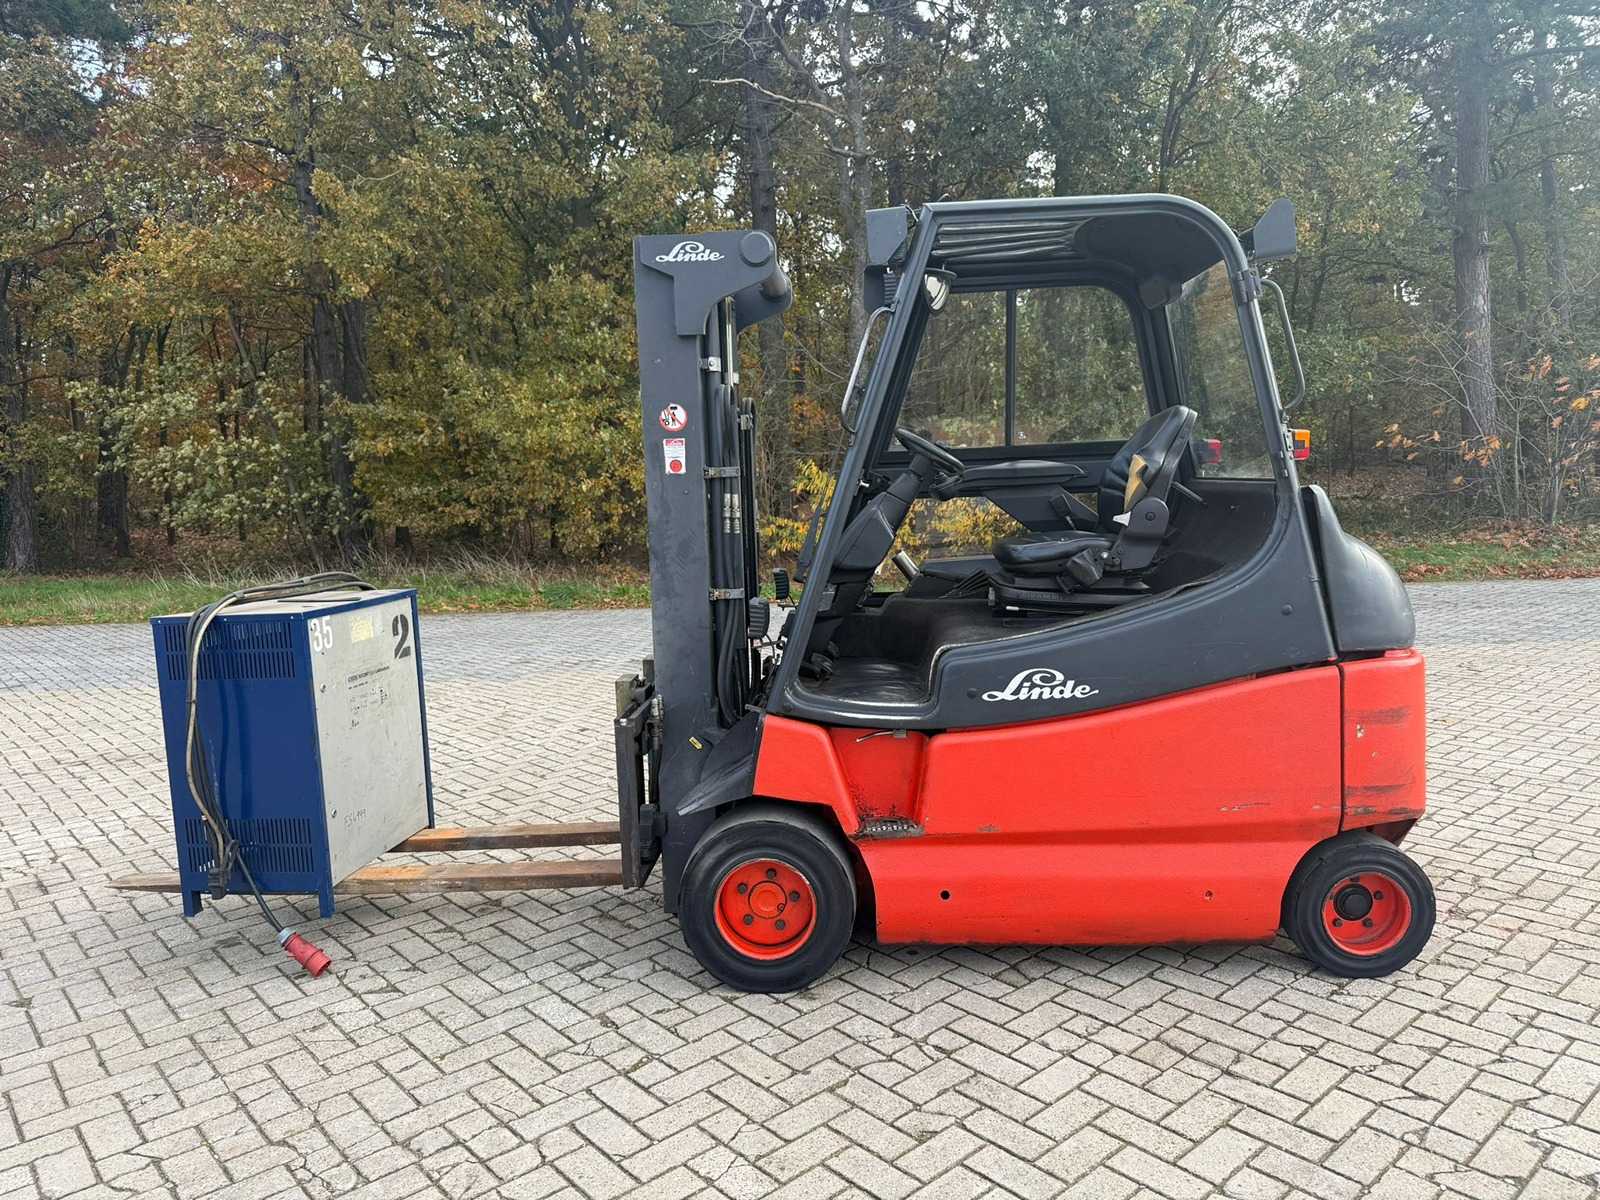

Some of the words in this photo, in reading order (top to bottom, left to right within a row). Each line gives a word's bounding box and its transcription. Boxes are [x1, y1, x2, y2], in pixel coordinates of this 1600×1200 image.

[655, 240, 726, 263] Linde
[310, 615, 333, 652] 35
[392, 613, 411, 660] 2
[981, 667, 1099, 702] Linde
